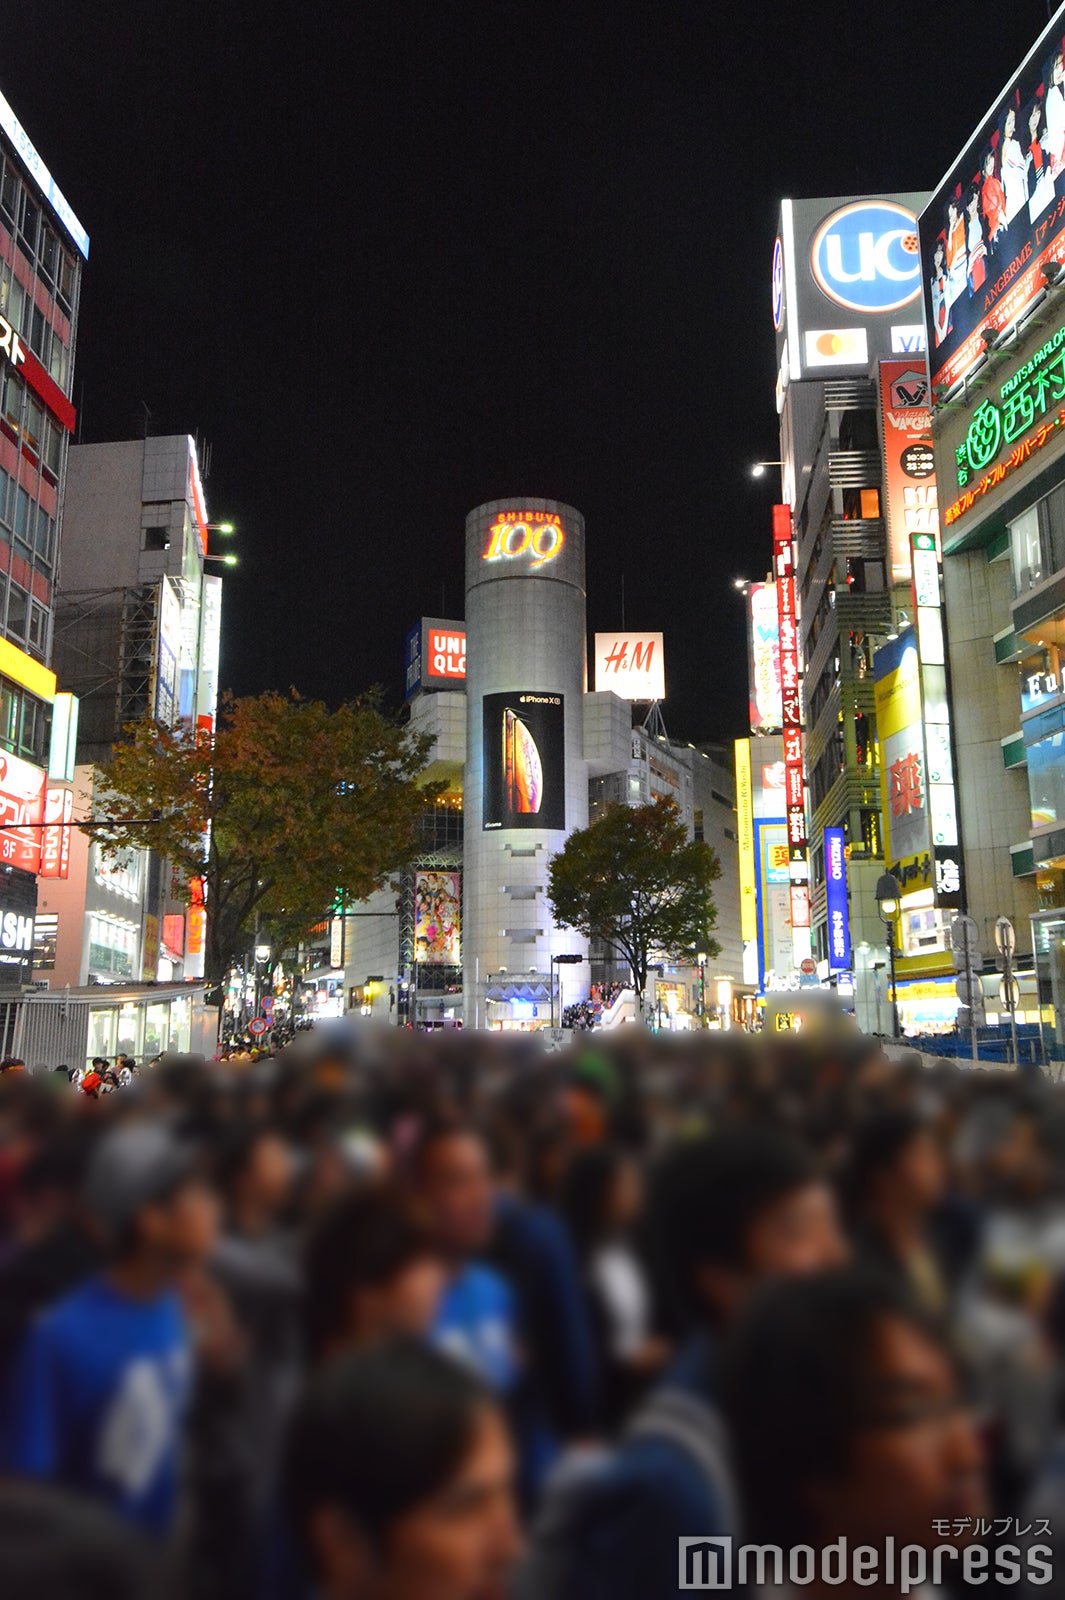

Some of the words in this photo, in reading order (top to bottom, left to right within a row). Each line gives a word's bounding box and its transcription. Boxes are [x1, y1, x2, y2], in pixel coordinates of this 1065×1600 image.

[983, 241, 1033, 311] ANGERME
[898, 335, 927, 353] VI
[887, 412, 934, 430] VANGUA
[956, 442, 968, 487] 渋谷
[497, 512, 561, 525] SHIBUYA
[482, 521, 565, 567] 109
[605, 640, 655, 673] H&M
[526, 696, 549, 704] iPhone
[1027, 667, 1065, 702] Eu
[3, 839, 16, 859] 3F
[830, 837, 842, 881] MIZUHO
